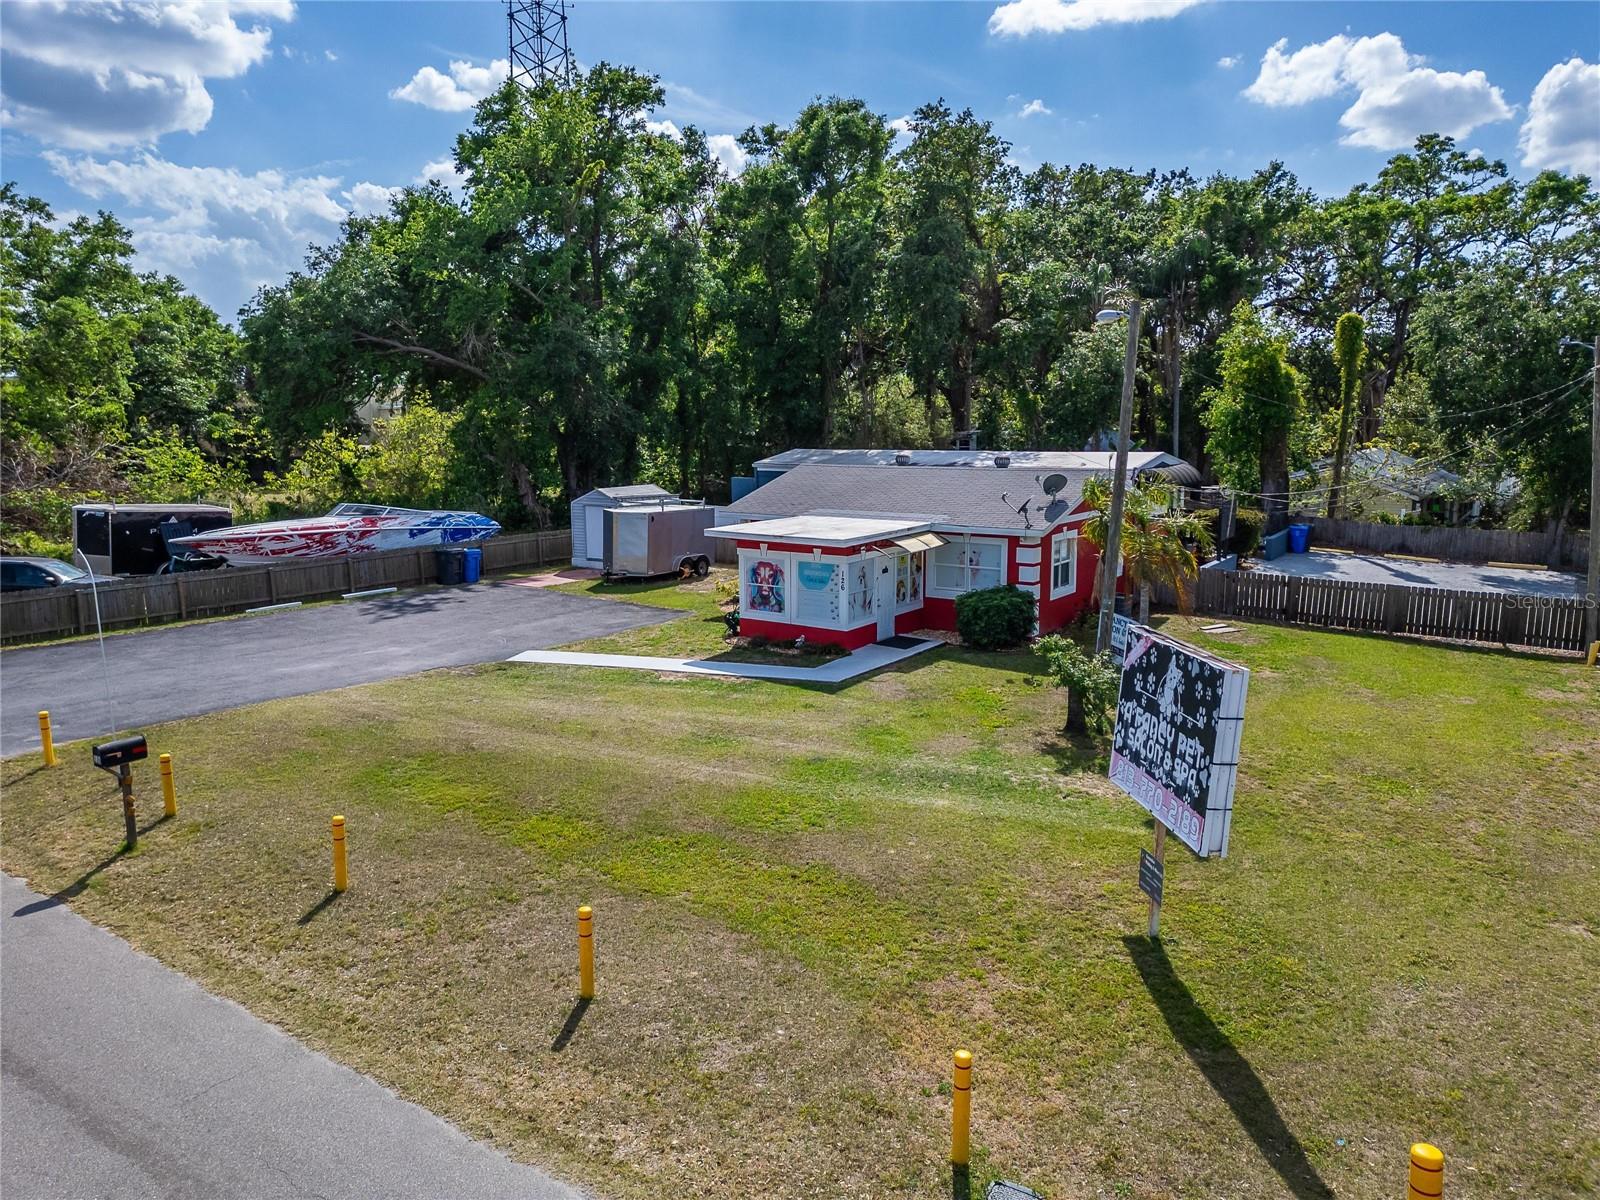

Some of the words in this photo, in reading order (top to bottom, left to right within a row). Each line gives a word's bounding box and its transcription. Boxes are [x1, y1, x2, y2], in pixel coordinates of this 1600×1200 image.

[1124, 701, 1133, 723] A
[1135, 707, 1175, 748] FANCY
[1177, 732, 1204, 768] PET
[1127, 727, 1162, 764] SALON
[1163, 751, 1172, 770] &
[1173, 758, 1197, 790] SPA
[1116, 760, 1199, 841] 813-770-2189
